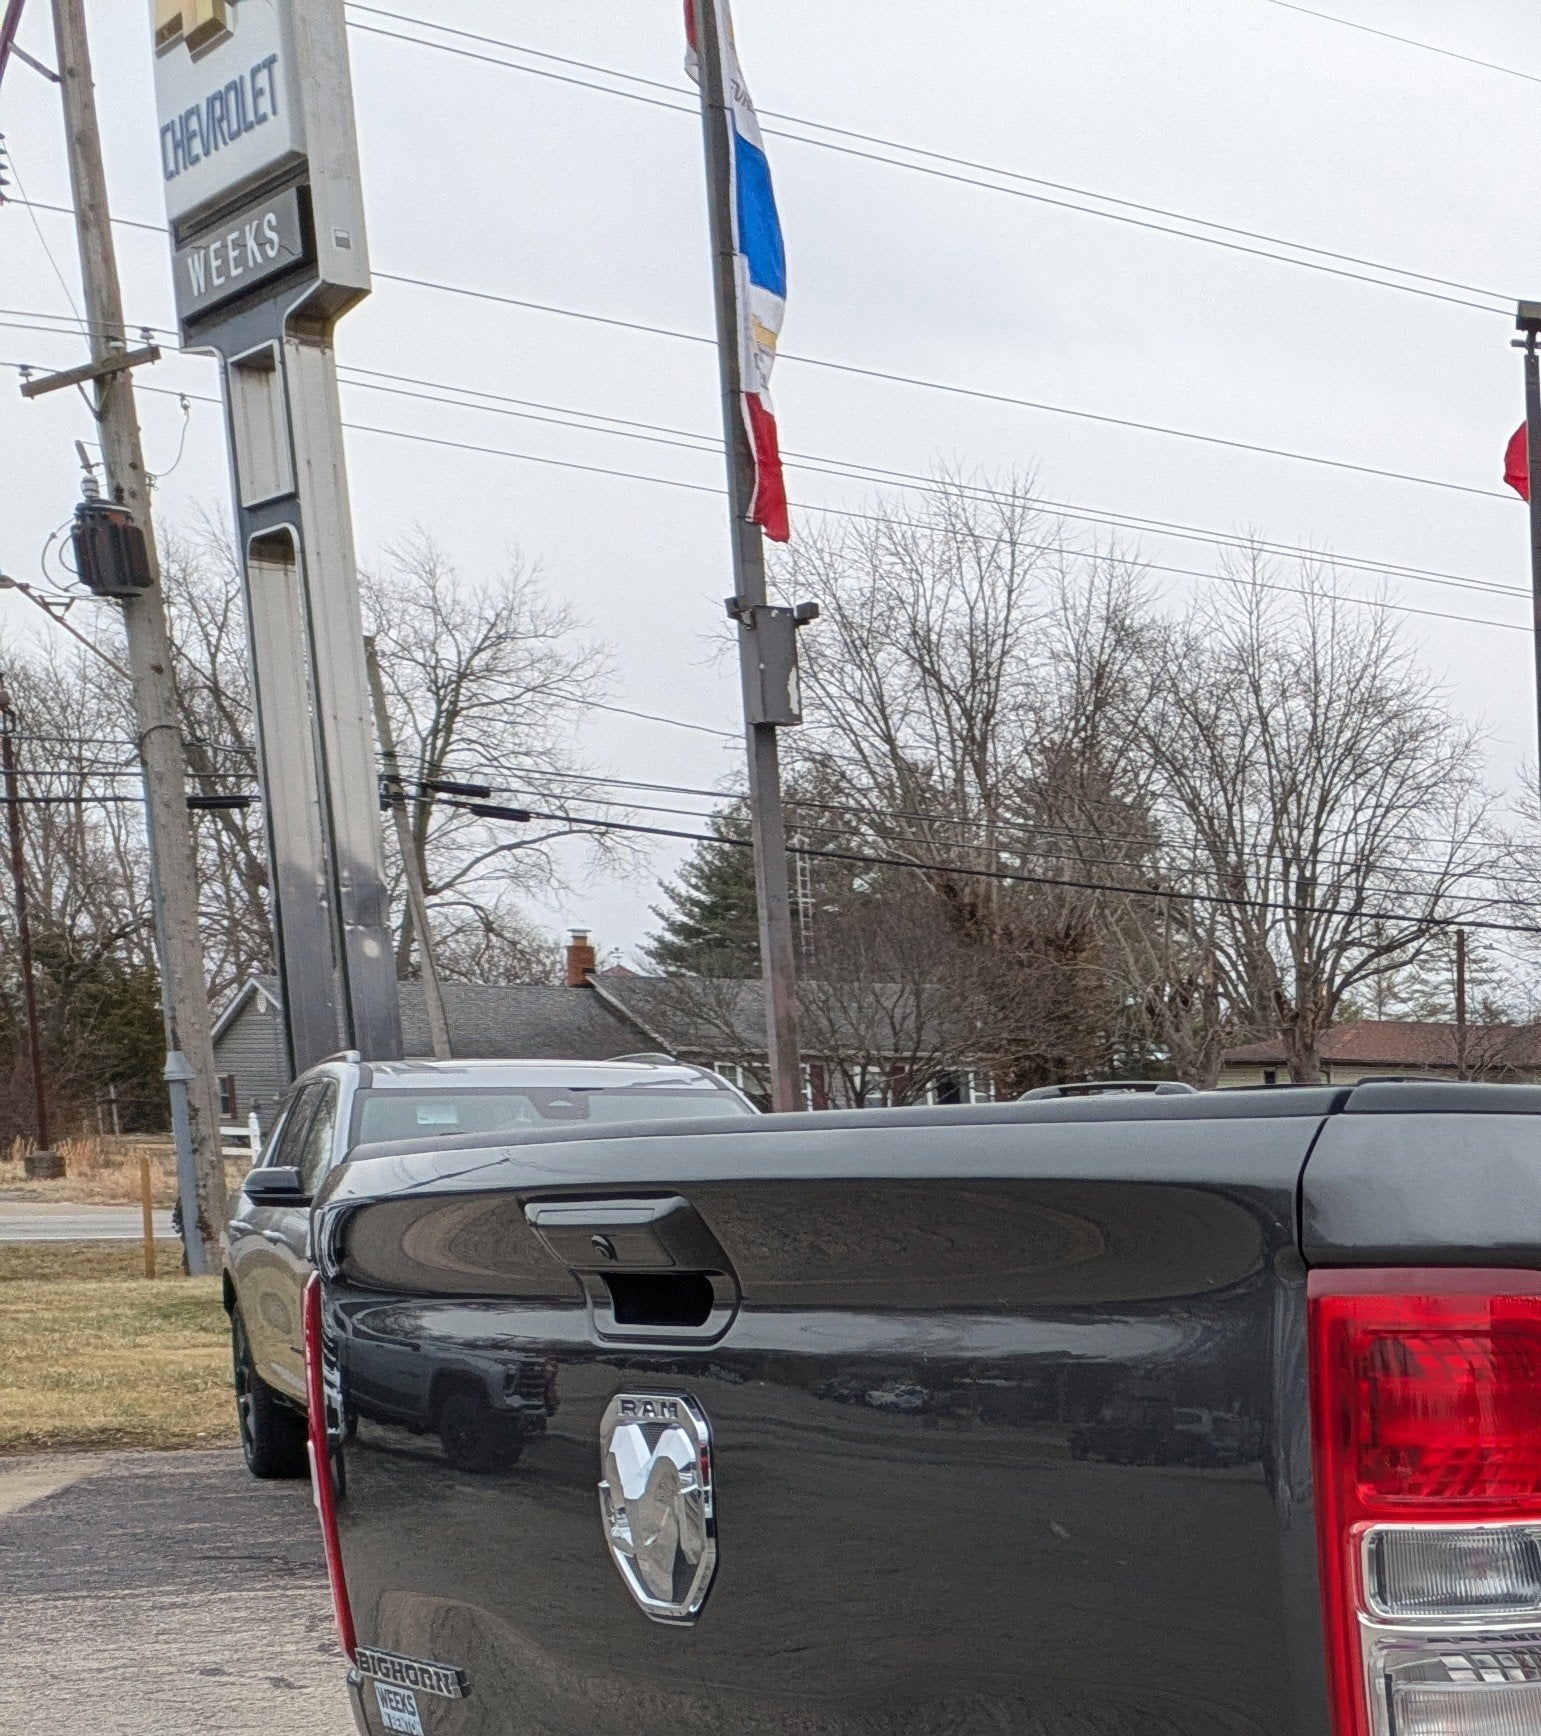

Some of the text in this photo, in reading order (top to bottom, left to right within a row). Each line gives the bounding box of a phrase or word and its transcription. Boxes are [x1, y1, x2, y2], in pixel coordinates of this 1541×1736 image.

[159, 53, 278, 181] CHEVROLET
[187, 212, 280, 297] WEEKS
[621, 1399, 678, 1419] RAM
[376, 1686, 416, 1717] WEEKS
